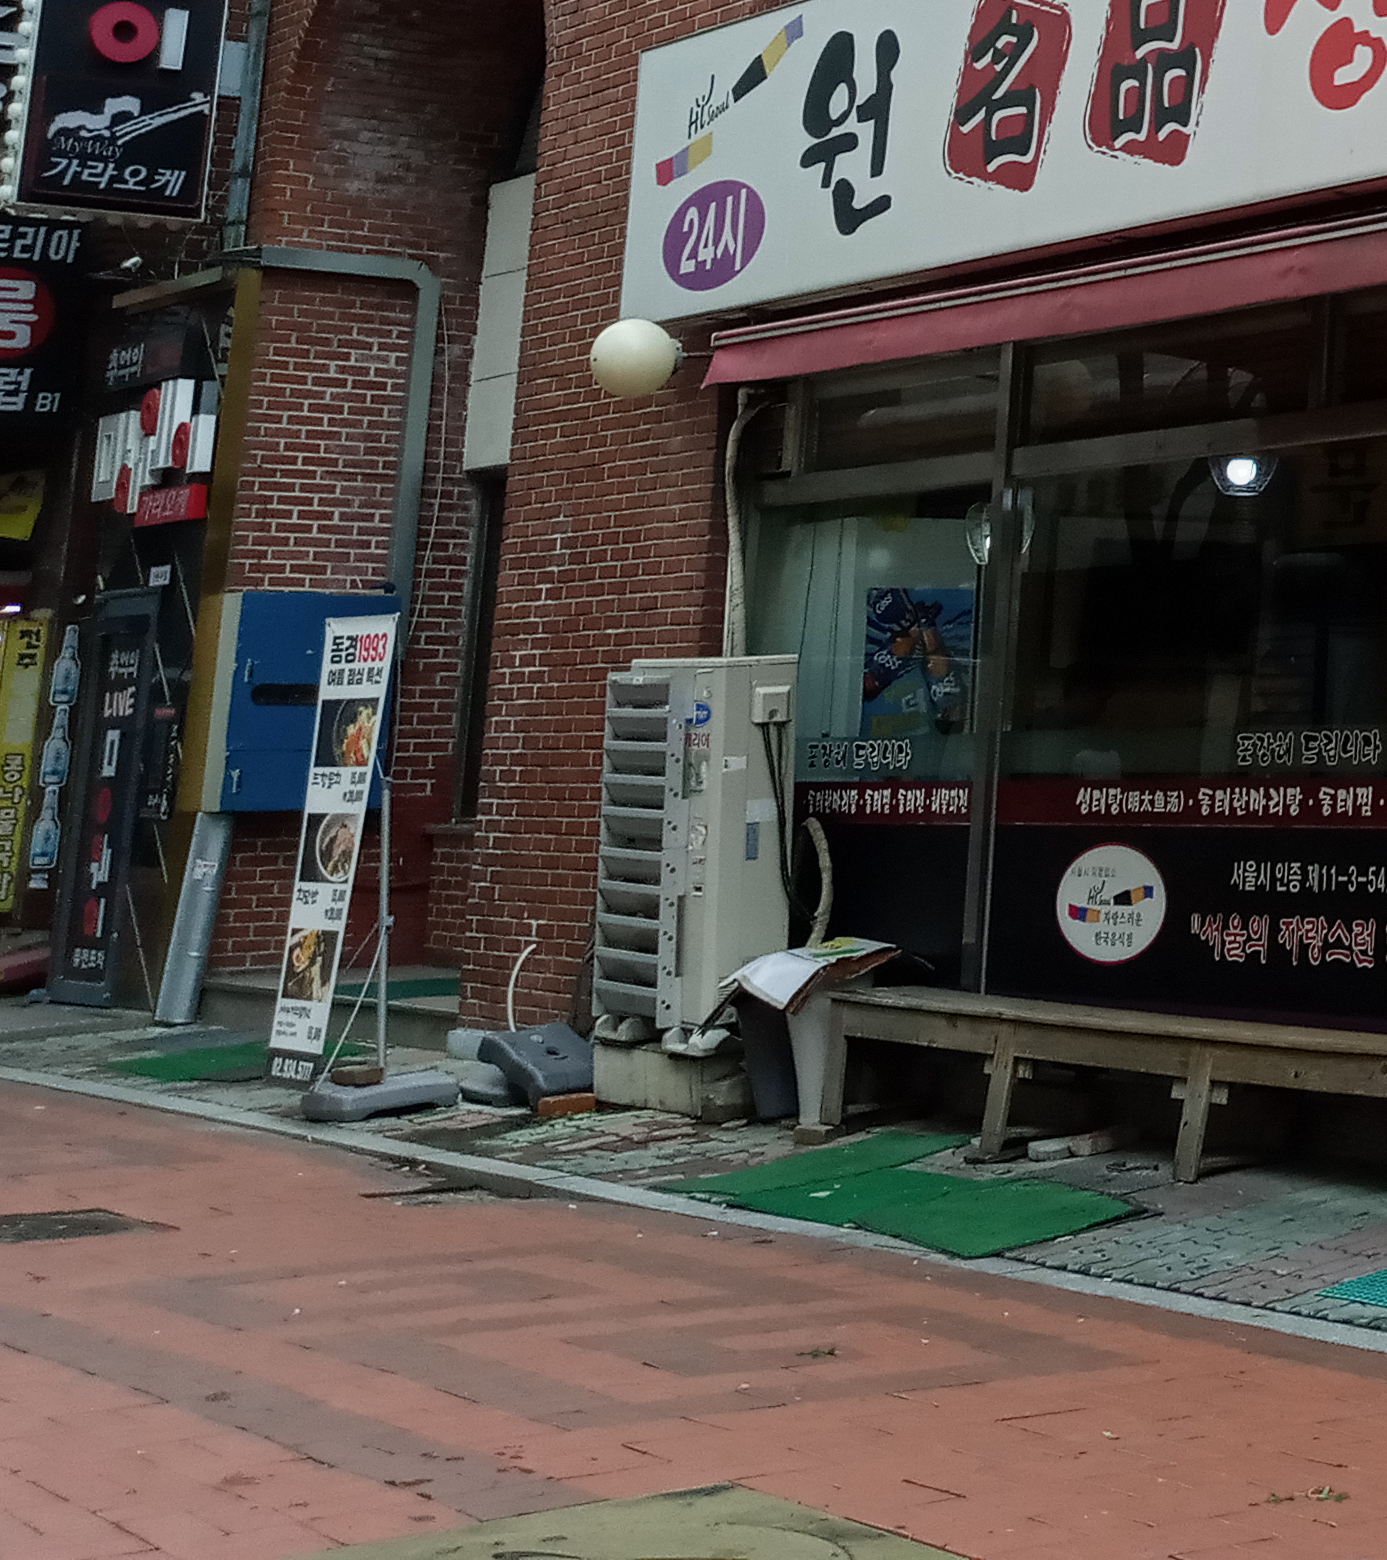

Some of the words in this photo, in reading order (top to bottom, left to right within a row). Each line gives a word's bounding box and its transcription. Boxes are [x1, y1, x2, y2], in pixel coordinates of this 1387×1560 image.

[800, 28, 900, 236] 원
[41, 156, 187, 197] 가라오케
[678, 188, 748, 276] 24시
[34, 392, 62, 413] B1
[331, 633, 388, 665] 동경1993
[104, 686, 136, 718] LIVE
[852, 739, 912, 771] 드립니다
[1236, 732, 1294, 766] 포장해
[1301, 730, 1382, 765] 드립니다
[1198, 785, 1303, 817] 동태한마리탕
[1318, 786, 1373, 817] 동태찜
[1231, 861, 1271, 892] 서울시
[1275, 862, 1302, 893] 인증
[1278, 916, 1376, 968] 자랑스런
